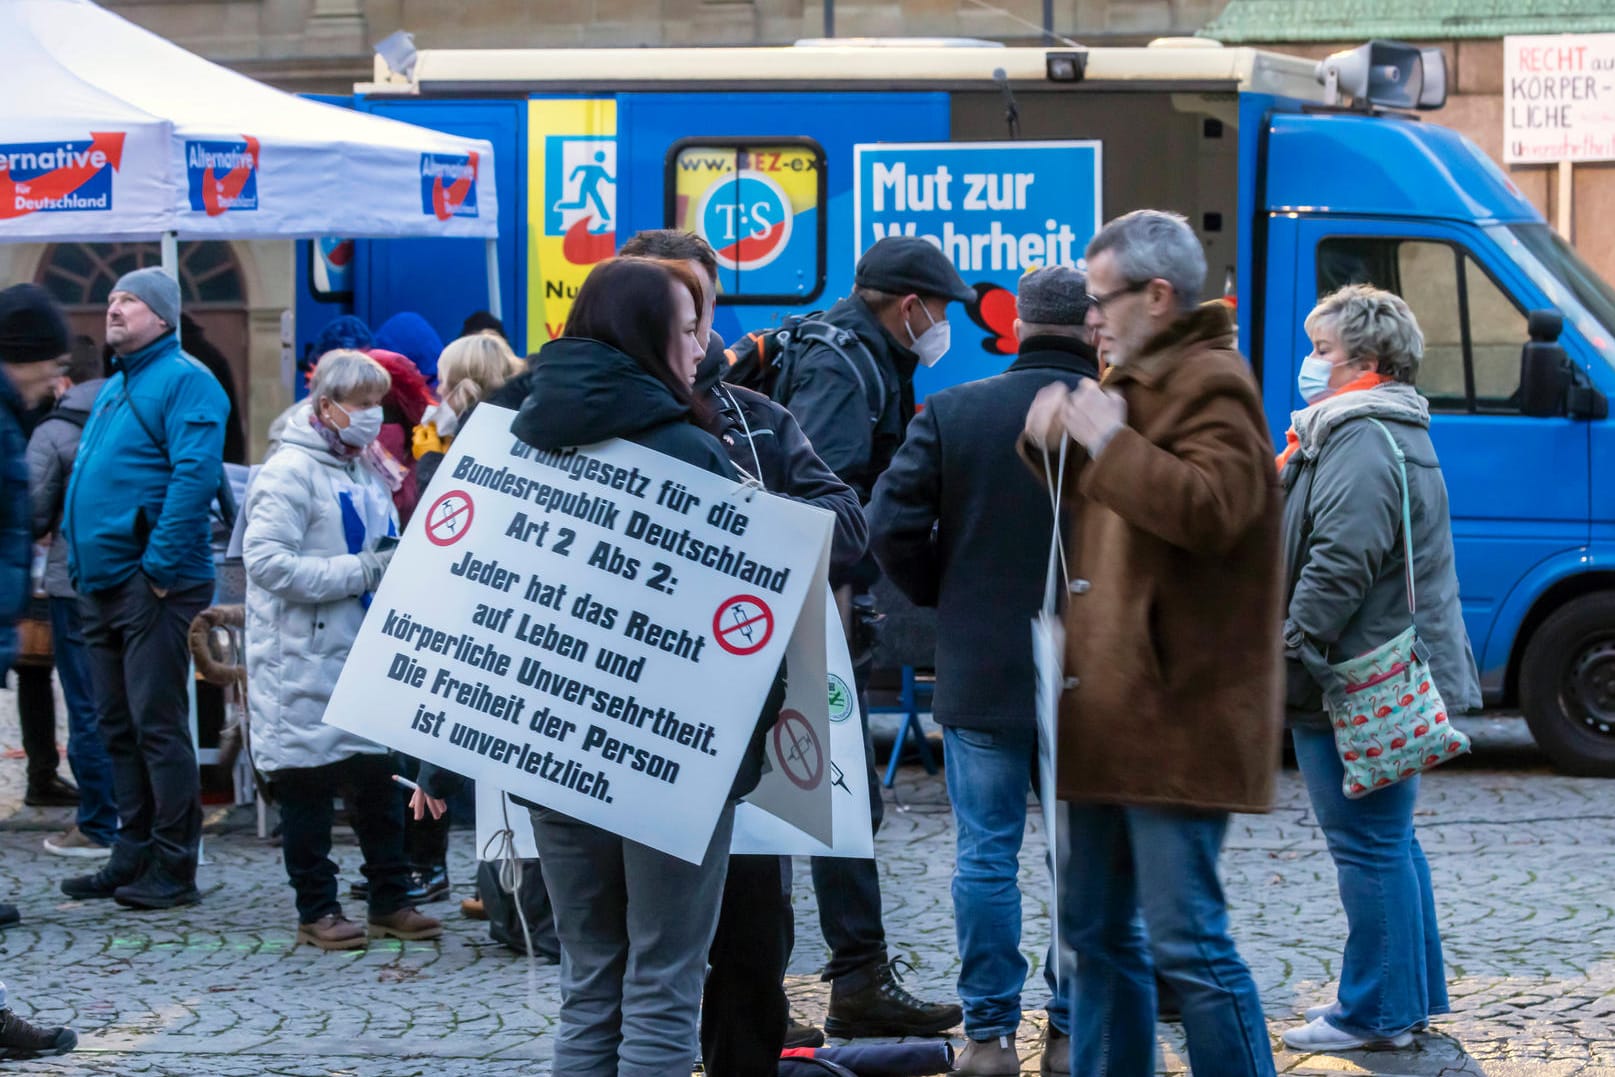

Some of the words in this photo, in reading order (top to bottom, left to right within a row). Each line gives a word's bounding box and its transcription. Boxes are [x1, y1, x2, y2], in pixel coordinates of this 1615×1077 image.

[1519, 46, 1588, 71] RECHT
[1511, 104, 1572, 129] LICHE
[15, 192, 107, 210] Deutschland
[872, 162, 952, 212] Mut
[963, 172, 1035, 210] zur
[872, 219, 1086, 271] hrheit.
[452, 455, 621, 531] Bundesrepublik
[623, 510, 792, 595] Deutschland
[655, 479, 701, 518] für
[706, 501, 750, 537] die
[505, 511, 550, 548] Art
[551, 527, 577, 557] 2
[587, 540, 641, 581] Abs
[645, 561, 679, 596] 2:
[450, 551, 521, 593] Jeder
[523, 574, 567, 612] hat
[570, 593, 619, 630] das
[623, 610, 706, 664] Recht
[472, 603, 515, 634] auf
[514, 613, 589, 663] Leben
[594, 647, 647, 685] und
[381, 609, 512, 677] körperliche
[516, 656, 718, 757] Unversehrtheit.
[387, 653, 427, 689] Die
[430, 668, 526, 725] Freiheit
[529, 706, 577, 742] der
[581, 724, 681, 785] Person
[411, 703, 446, 743] ist
[449, 722, 614, 804] unverletzlich.
